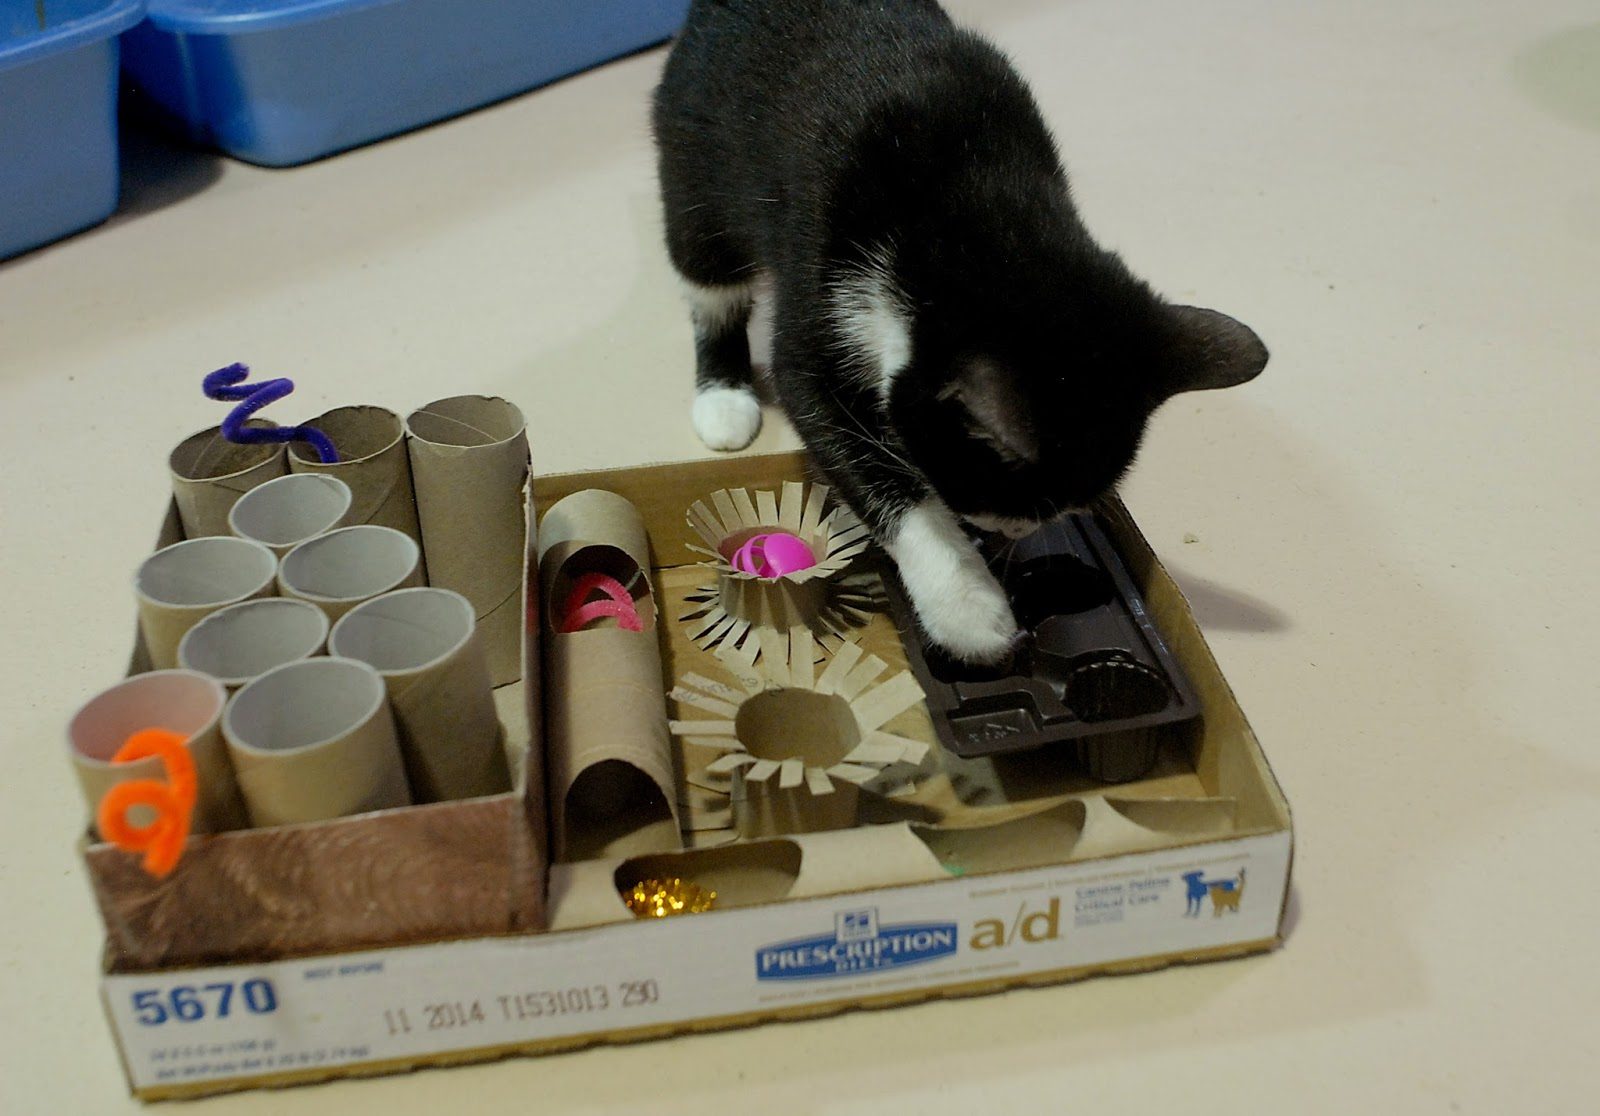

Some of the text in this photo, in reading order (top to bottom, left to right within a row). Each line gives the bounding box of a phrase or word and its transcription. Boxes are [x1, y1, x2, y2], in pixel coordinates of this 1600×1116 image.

[968, 896, 1060, 951] a/d
[761, 929, 952, 973] PRESCRIPTION
[131, 977, 278, 1026] 5670
[385, 1007, 413, 1035] 11
[424, 999, 486, 1030] 2014
[619, 979, 659, 1008] 290
